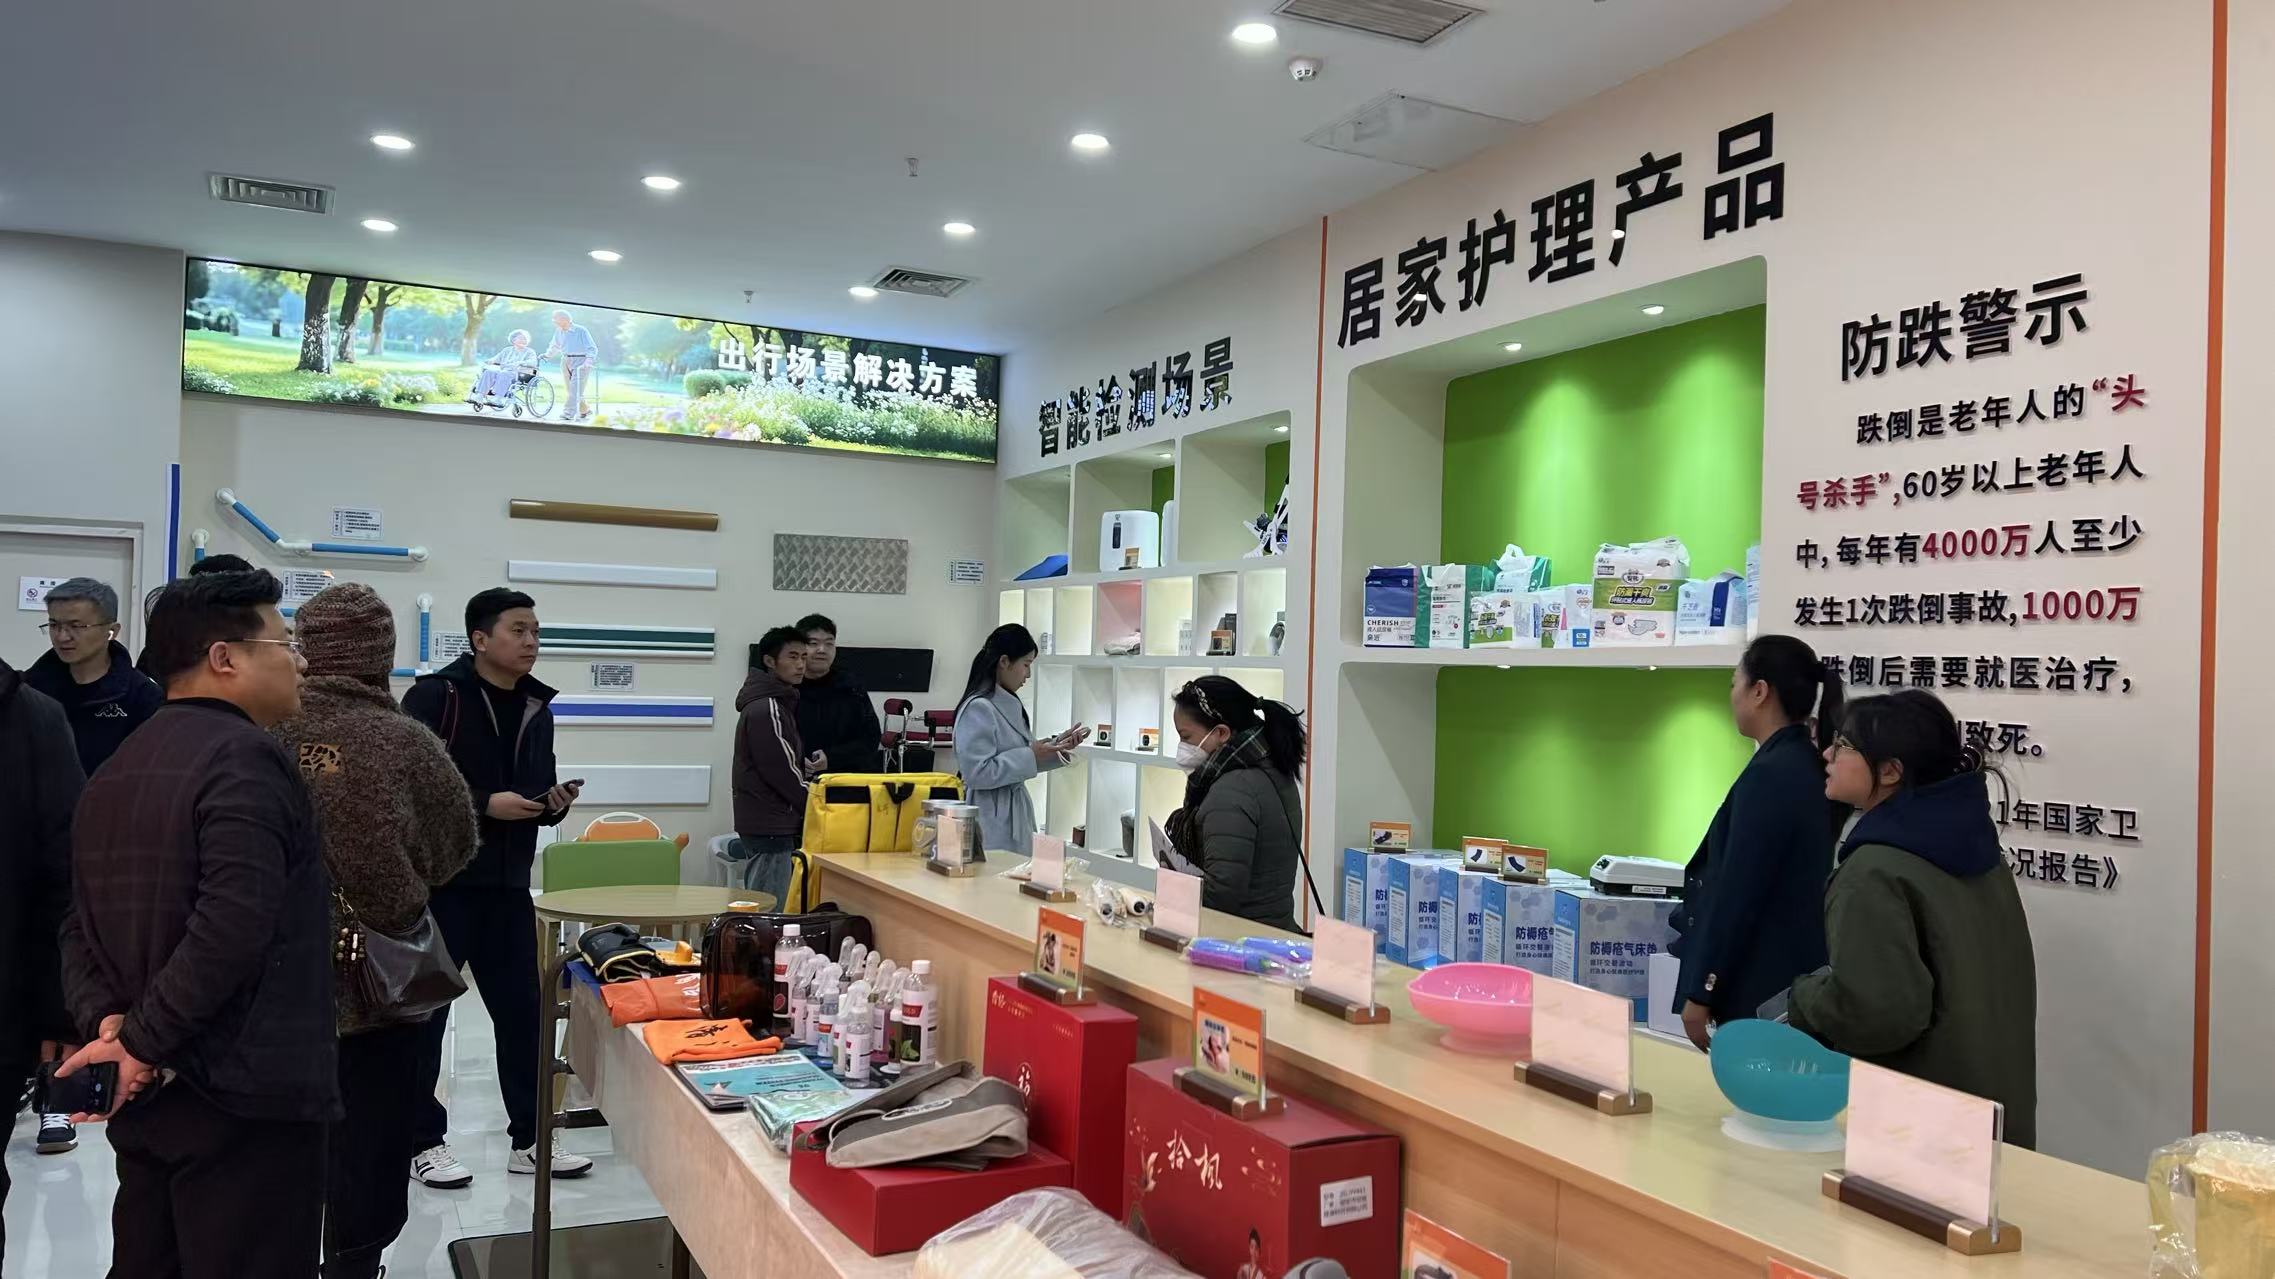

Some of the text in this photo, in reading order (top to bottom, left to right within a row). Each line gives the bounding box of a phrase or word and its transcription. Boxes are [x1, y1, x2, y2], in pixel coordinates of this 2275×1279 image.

[1337, 112, 1785, 349] 居家护理产品
[718, 337, 978, 399] 出行场景解决方案
[1841, 273, 2089, 381] 防跌警示
[1038, 336, 1234, 457] 智能检测场景
[1856, 374, 2145, 444] 跌倒是老年人的“头
